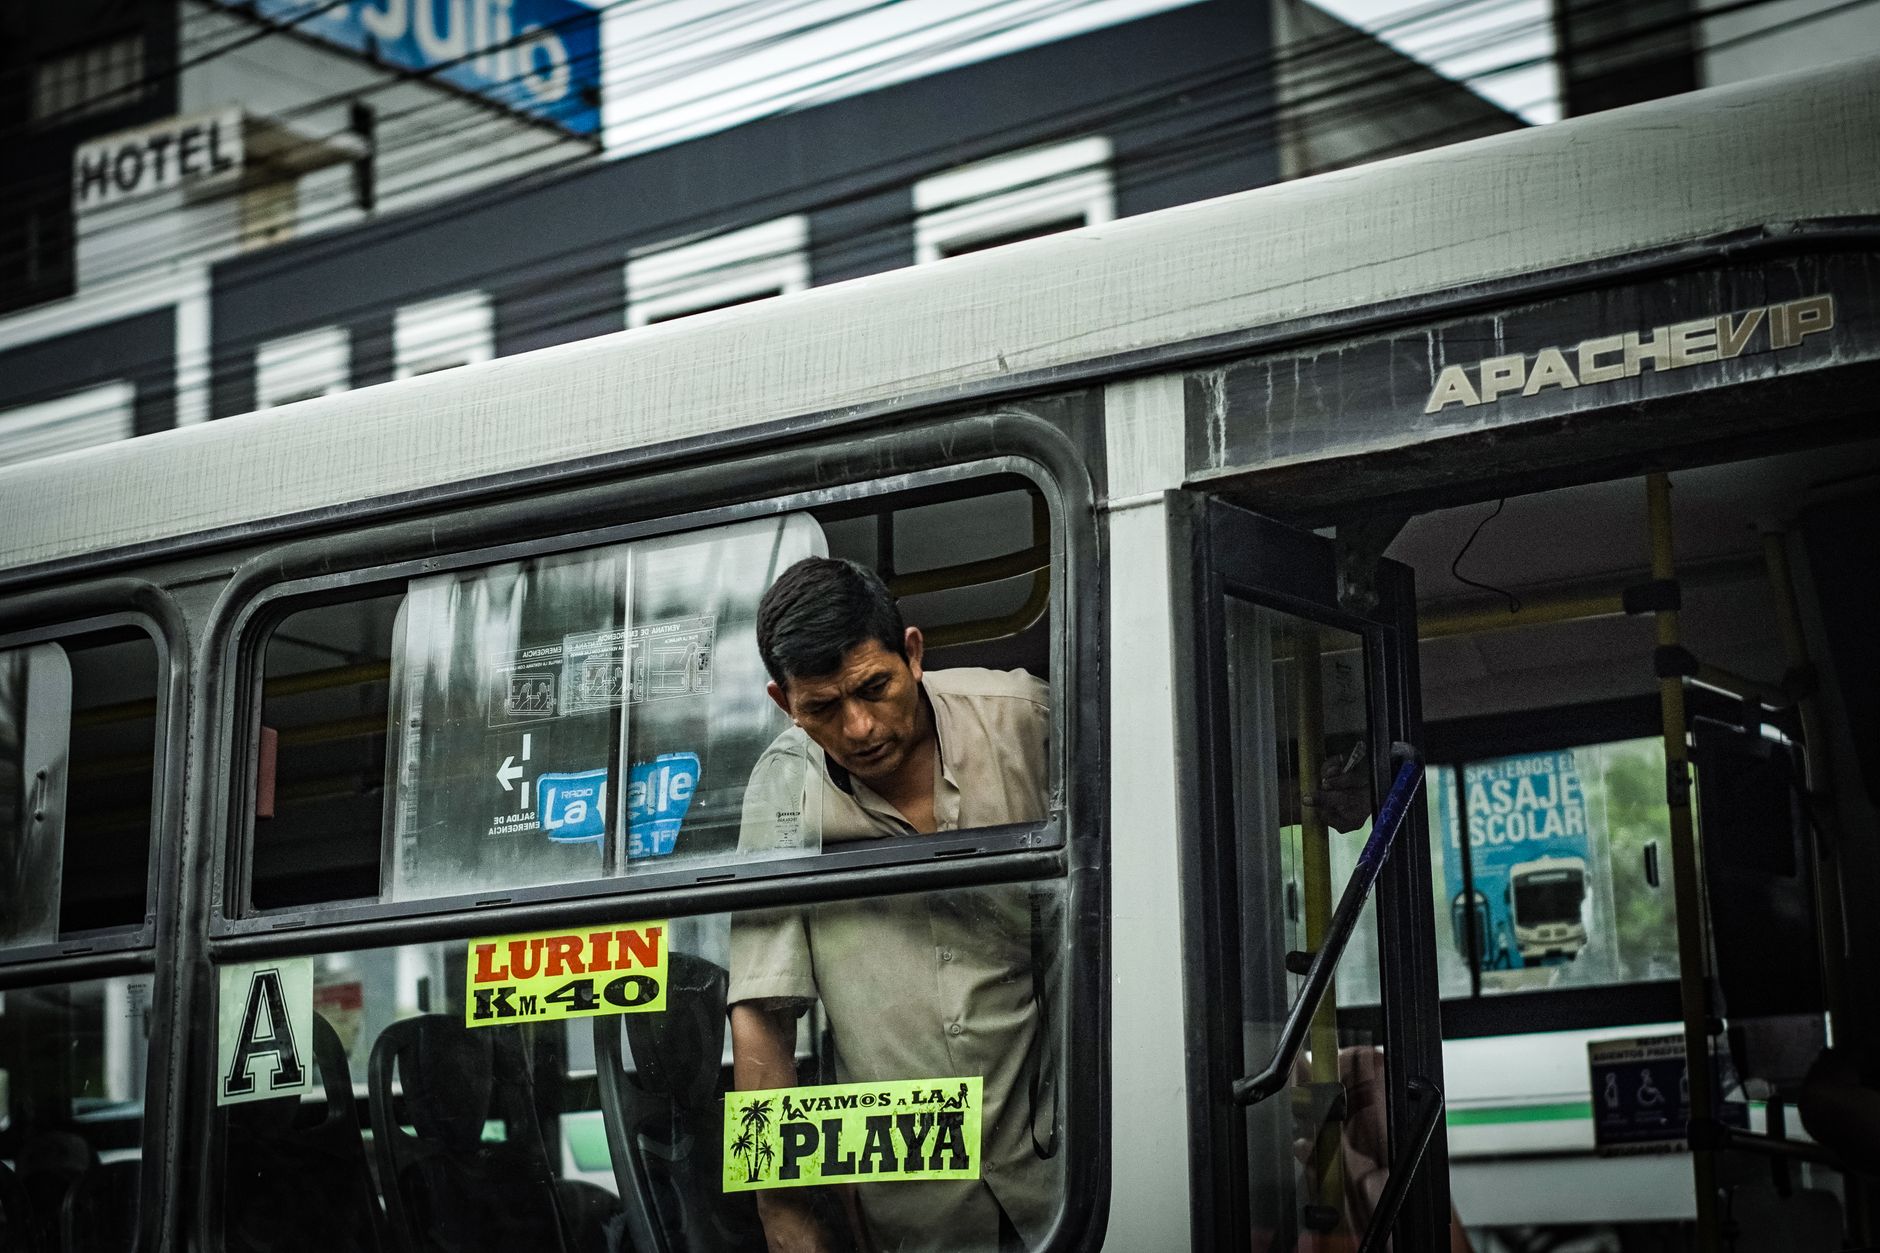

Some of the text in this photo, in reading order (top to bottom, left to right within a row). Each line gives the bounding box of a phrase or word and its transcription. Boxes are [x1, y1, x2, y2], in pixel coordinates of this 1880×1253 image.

[79, 123, 234, 200] HOTEL
[543, 788, 588, 831] La
[561, 788, 593, 799] RADIO
[474, 926, 663, 983] LURIN
[222, 968, 306, 1096] A
[800, 1092, 891, 1112] VAMOS
[912, 1089, 946, 1105] LA
[779, 1111, 970, 1180] PLAYA
